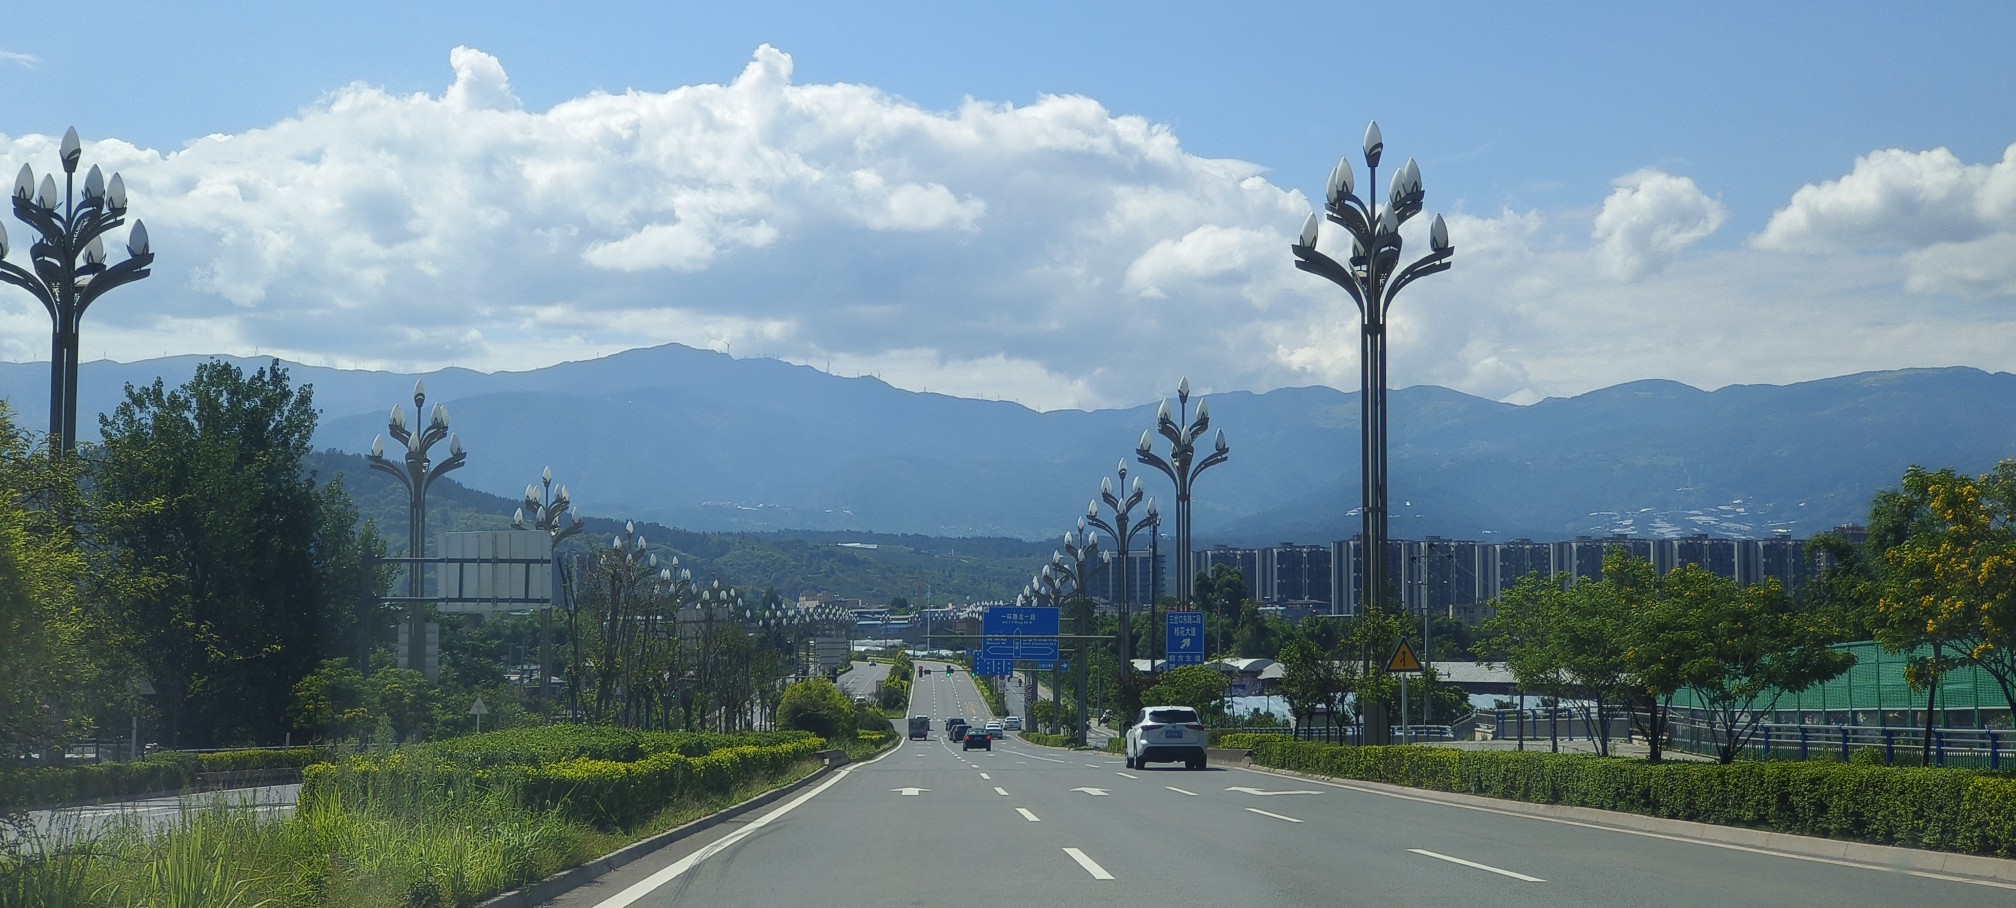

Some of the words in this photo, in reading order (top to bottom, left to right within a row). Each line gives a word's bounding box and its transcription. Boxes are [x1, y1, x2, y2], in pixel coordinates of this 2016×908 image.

[1169, 614, 1201, 624] 三岔口东路二段
[1174, 627, 1196, 636] 桂花大道
